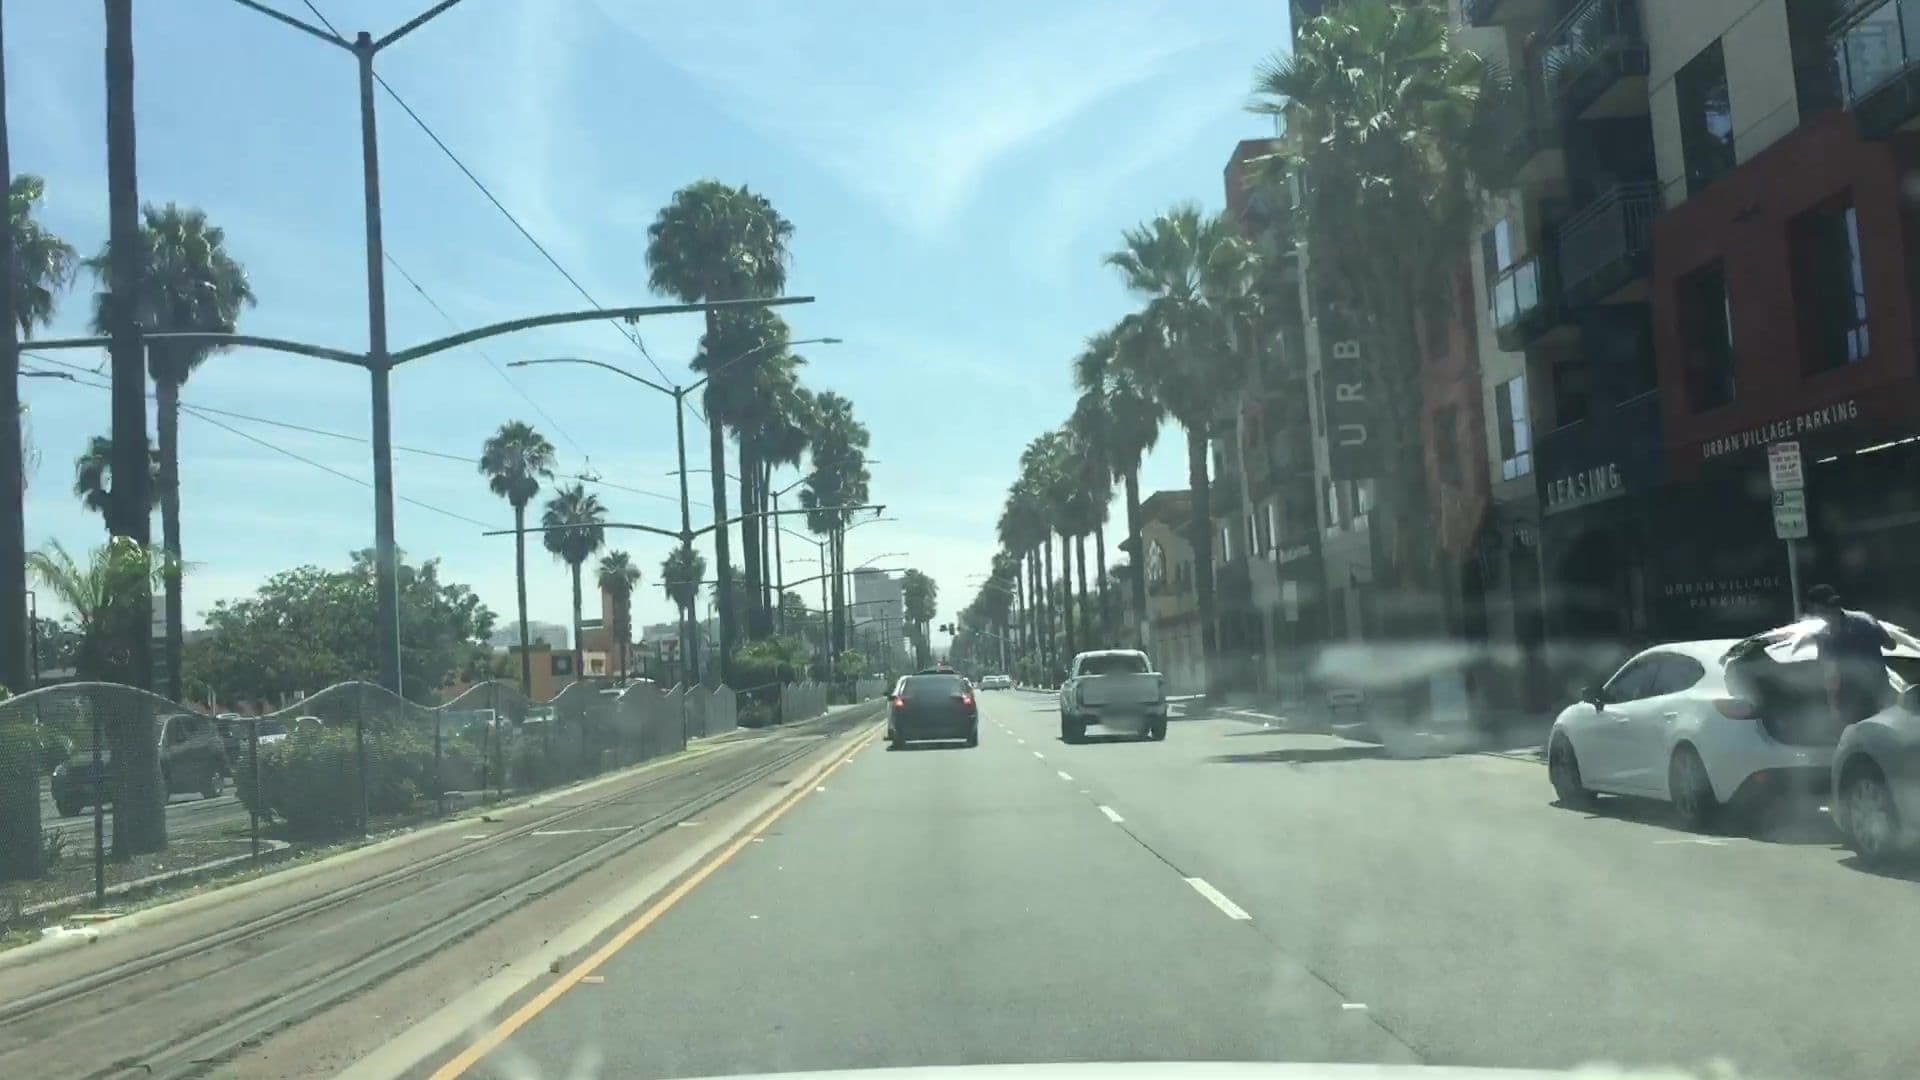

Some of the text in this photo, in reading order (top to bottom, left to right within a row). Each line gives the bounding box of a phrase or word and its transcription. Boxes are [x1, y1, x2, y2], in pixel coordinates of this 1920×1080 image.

[1702, 400, 1858, 458] URBAN VILLAGE PARKING
[1547, 463, 1618, 505] LEASING
